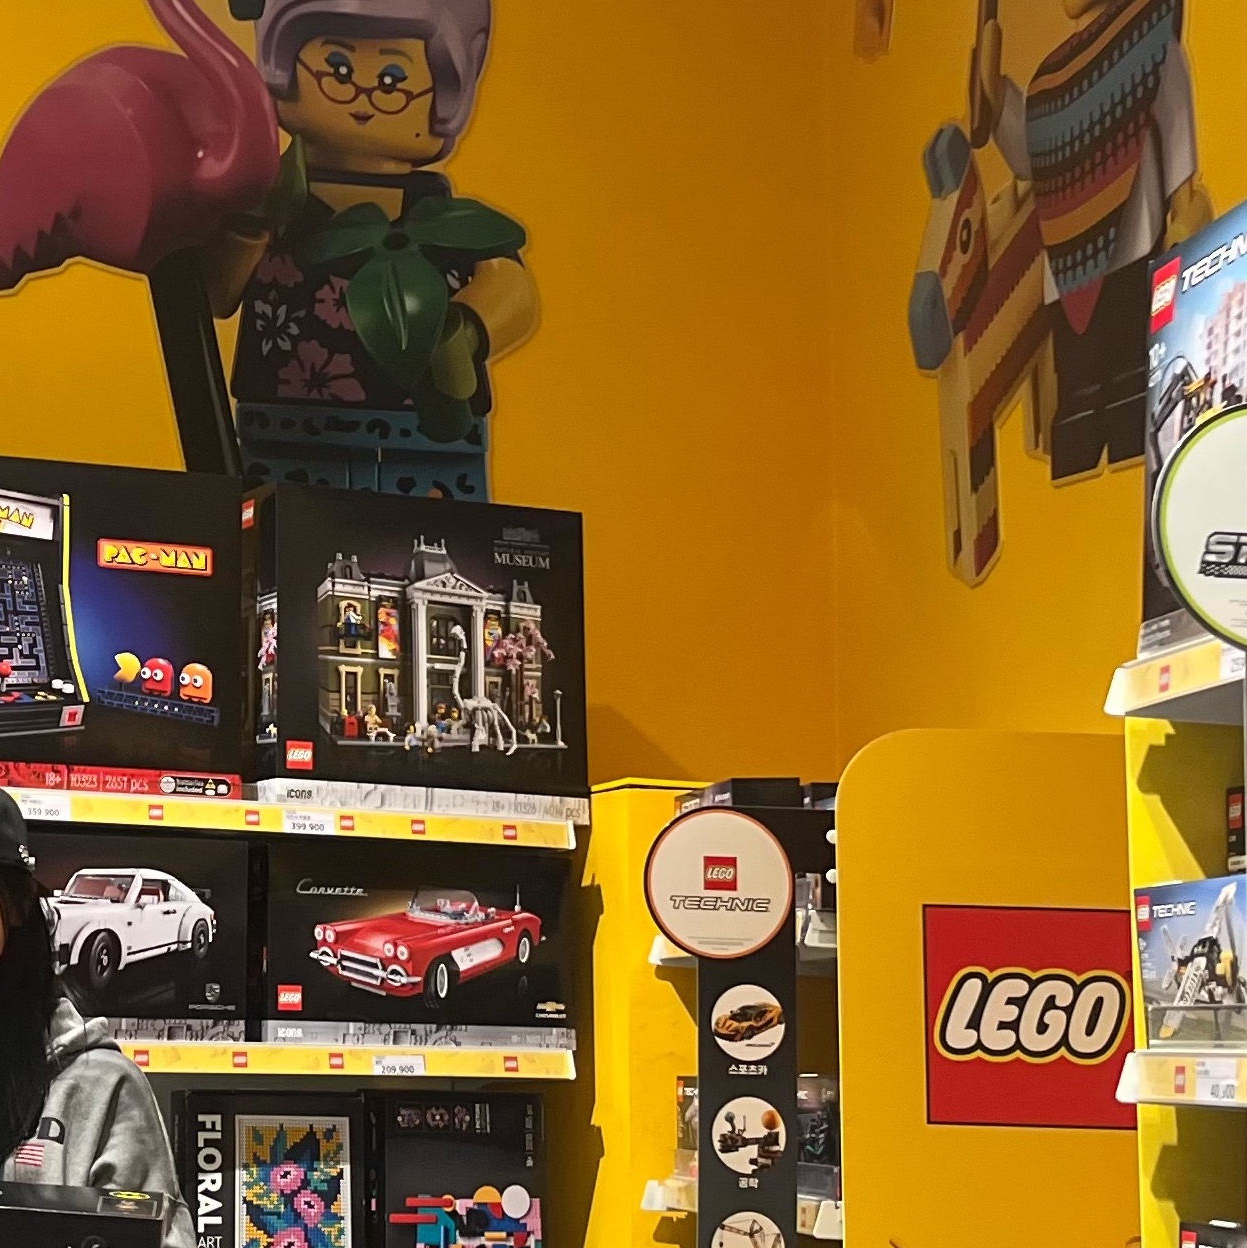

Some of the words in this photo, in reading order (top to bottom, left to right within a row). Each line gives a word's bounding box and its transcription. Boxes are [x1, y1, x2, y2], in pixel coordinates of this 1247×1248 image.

[103, 544, 208, 572] PAC-MAN
[494, 553, 551, 570] MUSEUM
[286, 749, 312, 761] LEGO
[45, 771, 62, 786] 18+
[69, 773, 98, 787] 10323
[130, 779, 149, 793] pcs
[565, 807, 582, 819] pcs
[705, 866, 737, 882] LEGO
[296, 878, 369, 898] Corvette
[670, 895, 771, 913] TECHNIC
[1153, 902, 1196, 918] TECHNIC
[279, 990, 303, 1004] LEGO
[939, 968, 1128, 1060] LEGO
[728, 1064, 768, 1077] 스포츠카
[197, 1114, 223, 1233] FLORAL
